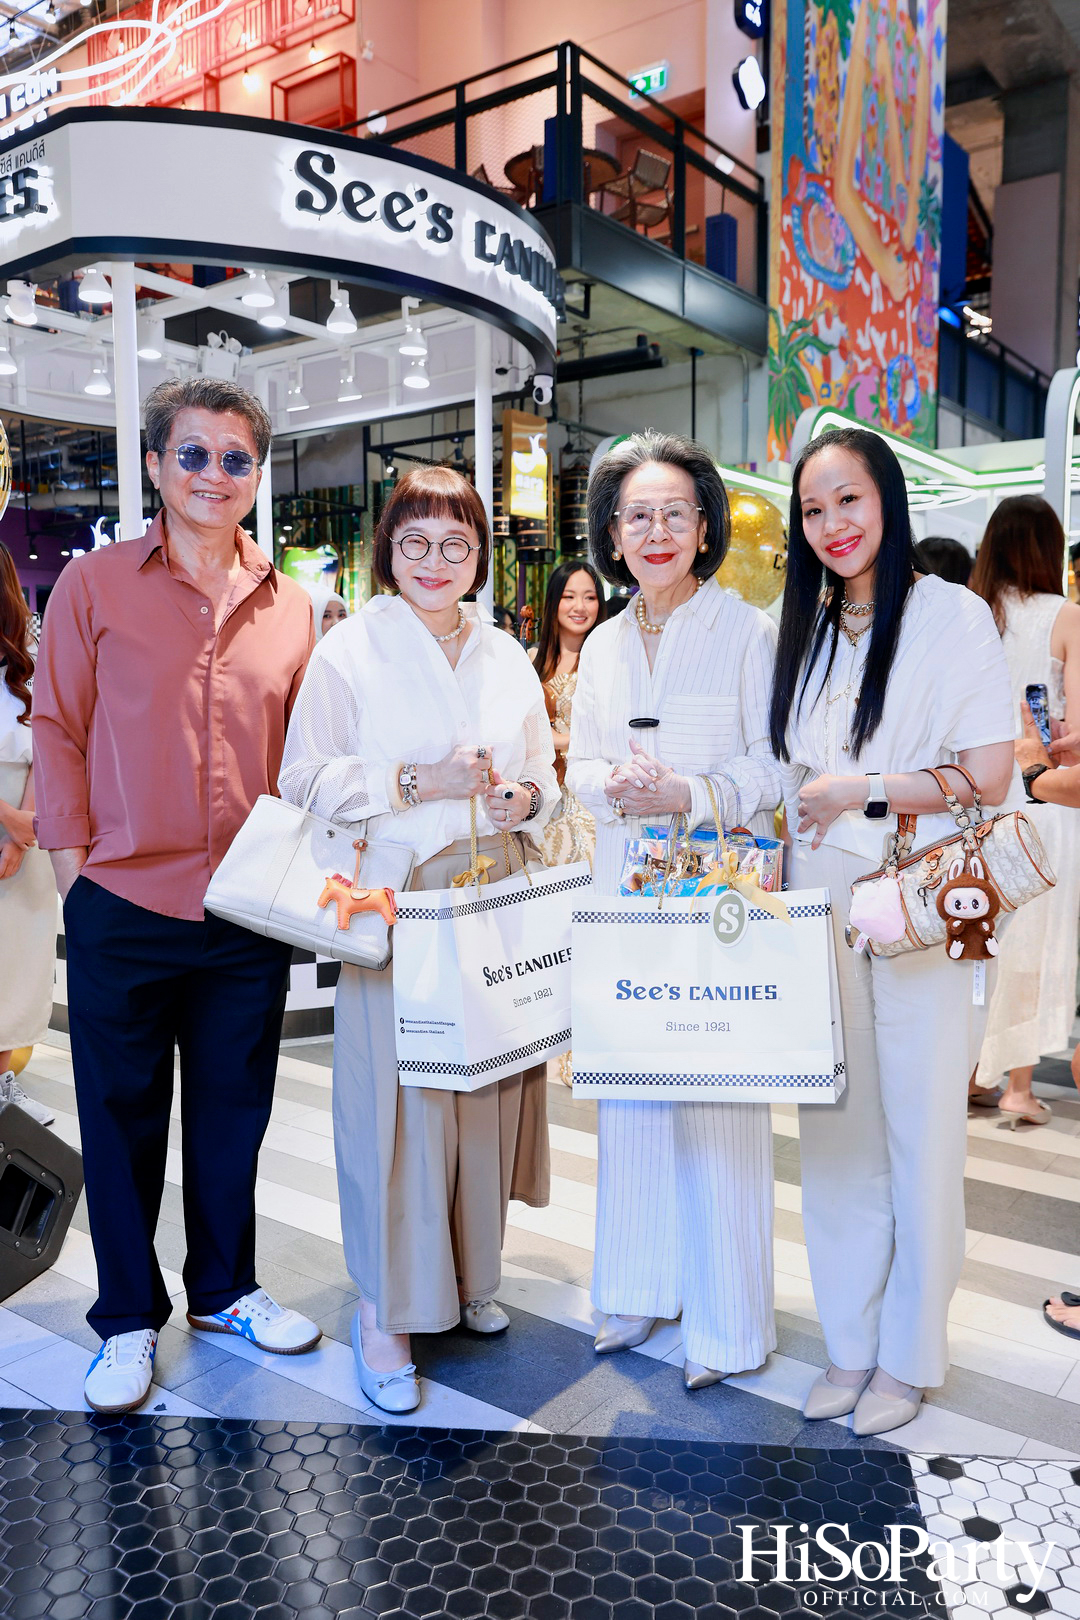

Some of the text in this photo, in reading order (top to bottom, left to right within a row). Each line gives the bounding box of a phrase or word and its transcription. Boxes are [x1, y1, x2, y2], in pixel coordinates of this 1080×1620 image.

[294, 150, 453, 243] See's
[718, 903, 739, 934] S
[482, 964, 513, 987] See's
[512, 987, 553, 1008] Since 1921
[616, 979, 777, 1000] See's CANDIES
[665, 1021, 731, 1032] Since 1921
